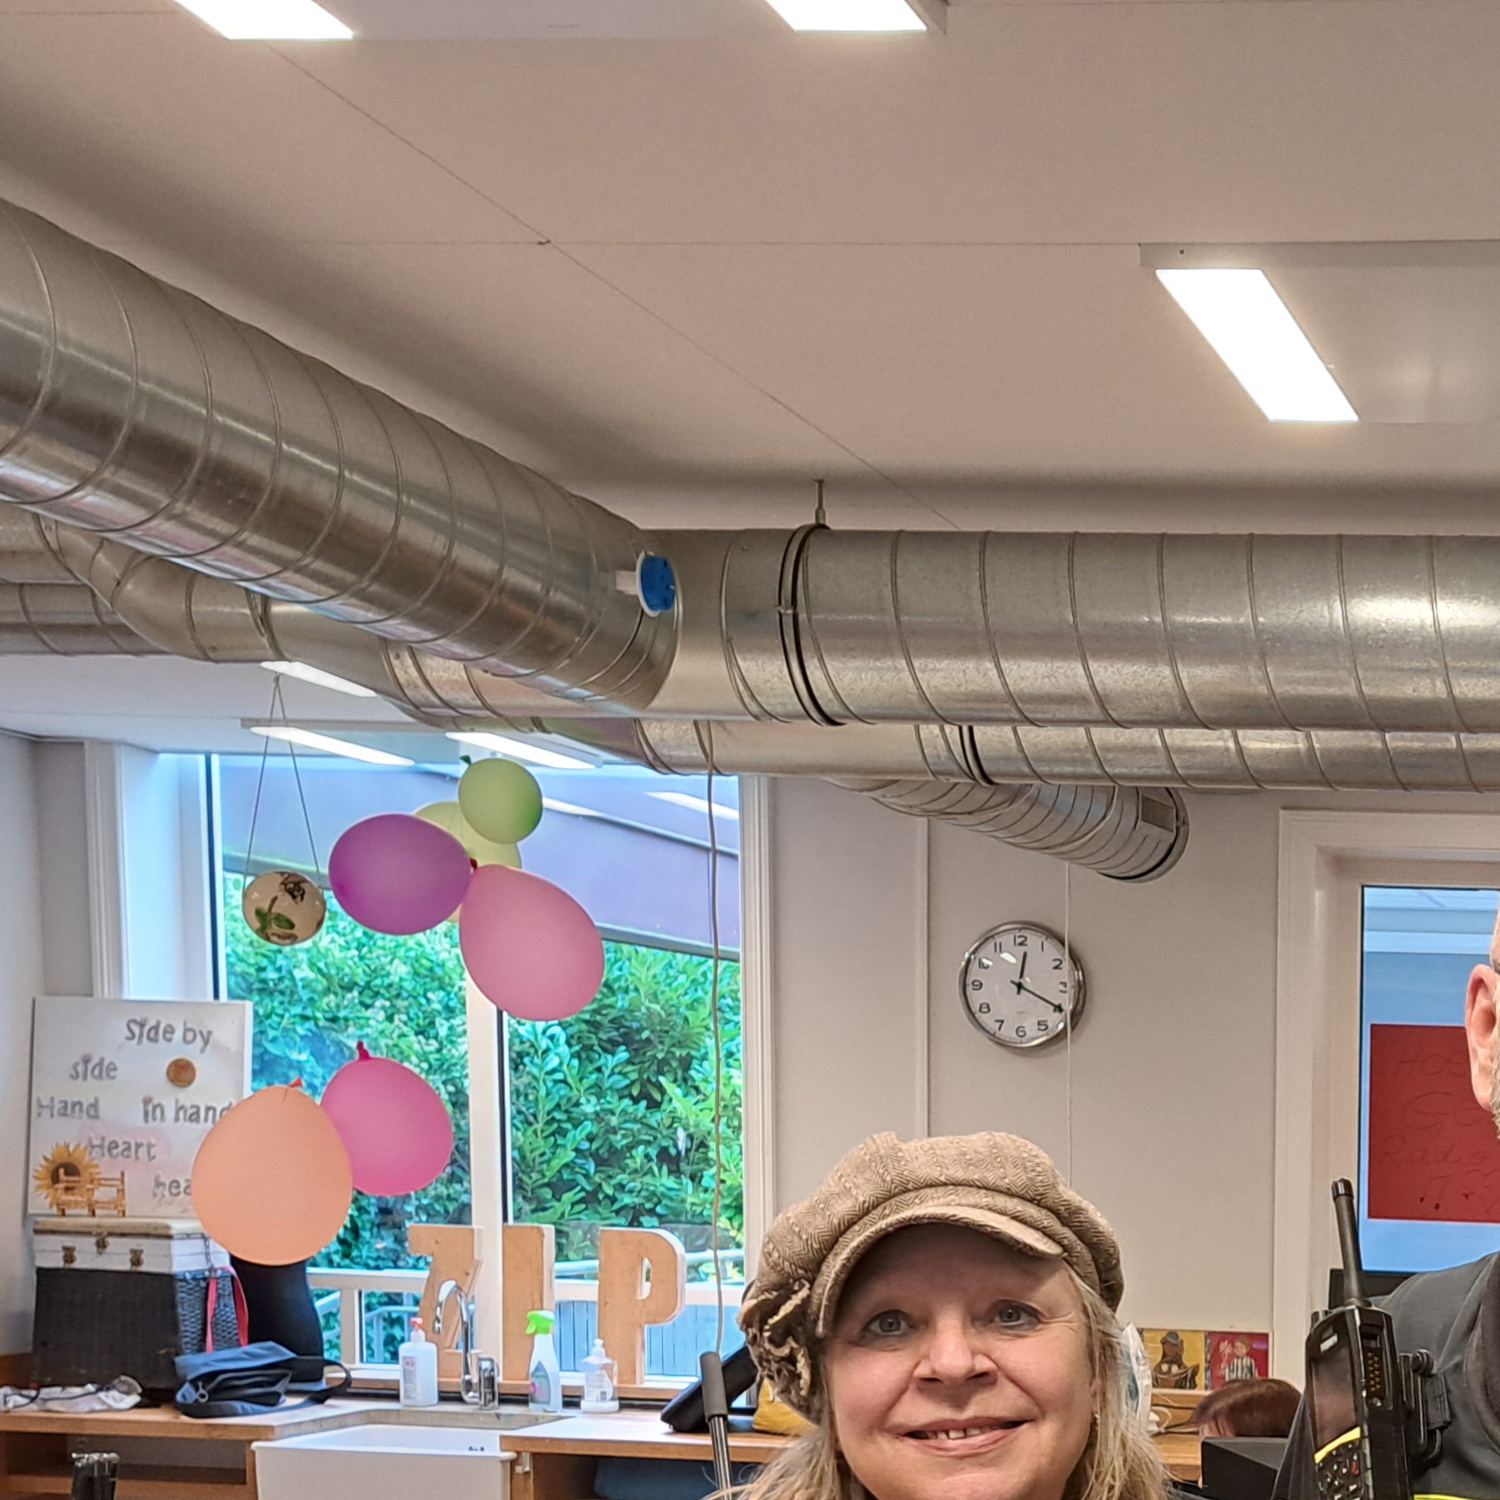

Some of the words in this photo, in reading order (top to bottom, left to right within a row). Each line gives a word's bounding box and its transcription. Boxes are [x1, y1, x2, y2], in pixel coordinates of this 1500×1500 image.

[1013, 935, 1028, 947] 12
[1051, 958, 1063, 970] 2
[971, 979, 983, 991] 9
[978, 1002, 991, 1014] 8
[994, 1019, 1005, 1032] 7
[1036, 1020, 1049, 1032] 5
[182, 1020, 213, 1053] by
[1015, 1026, 1027, 1038] 6
[36, 1096, 100, 1120] Hand
[88, 1135, 157, 1163] Heart
[152, 1174, 192, 1199] hea
